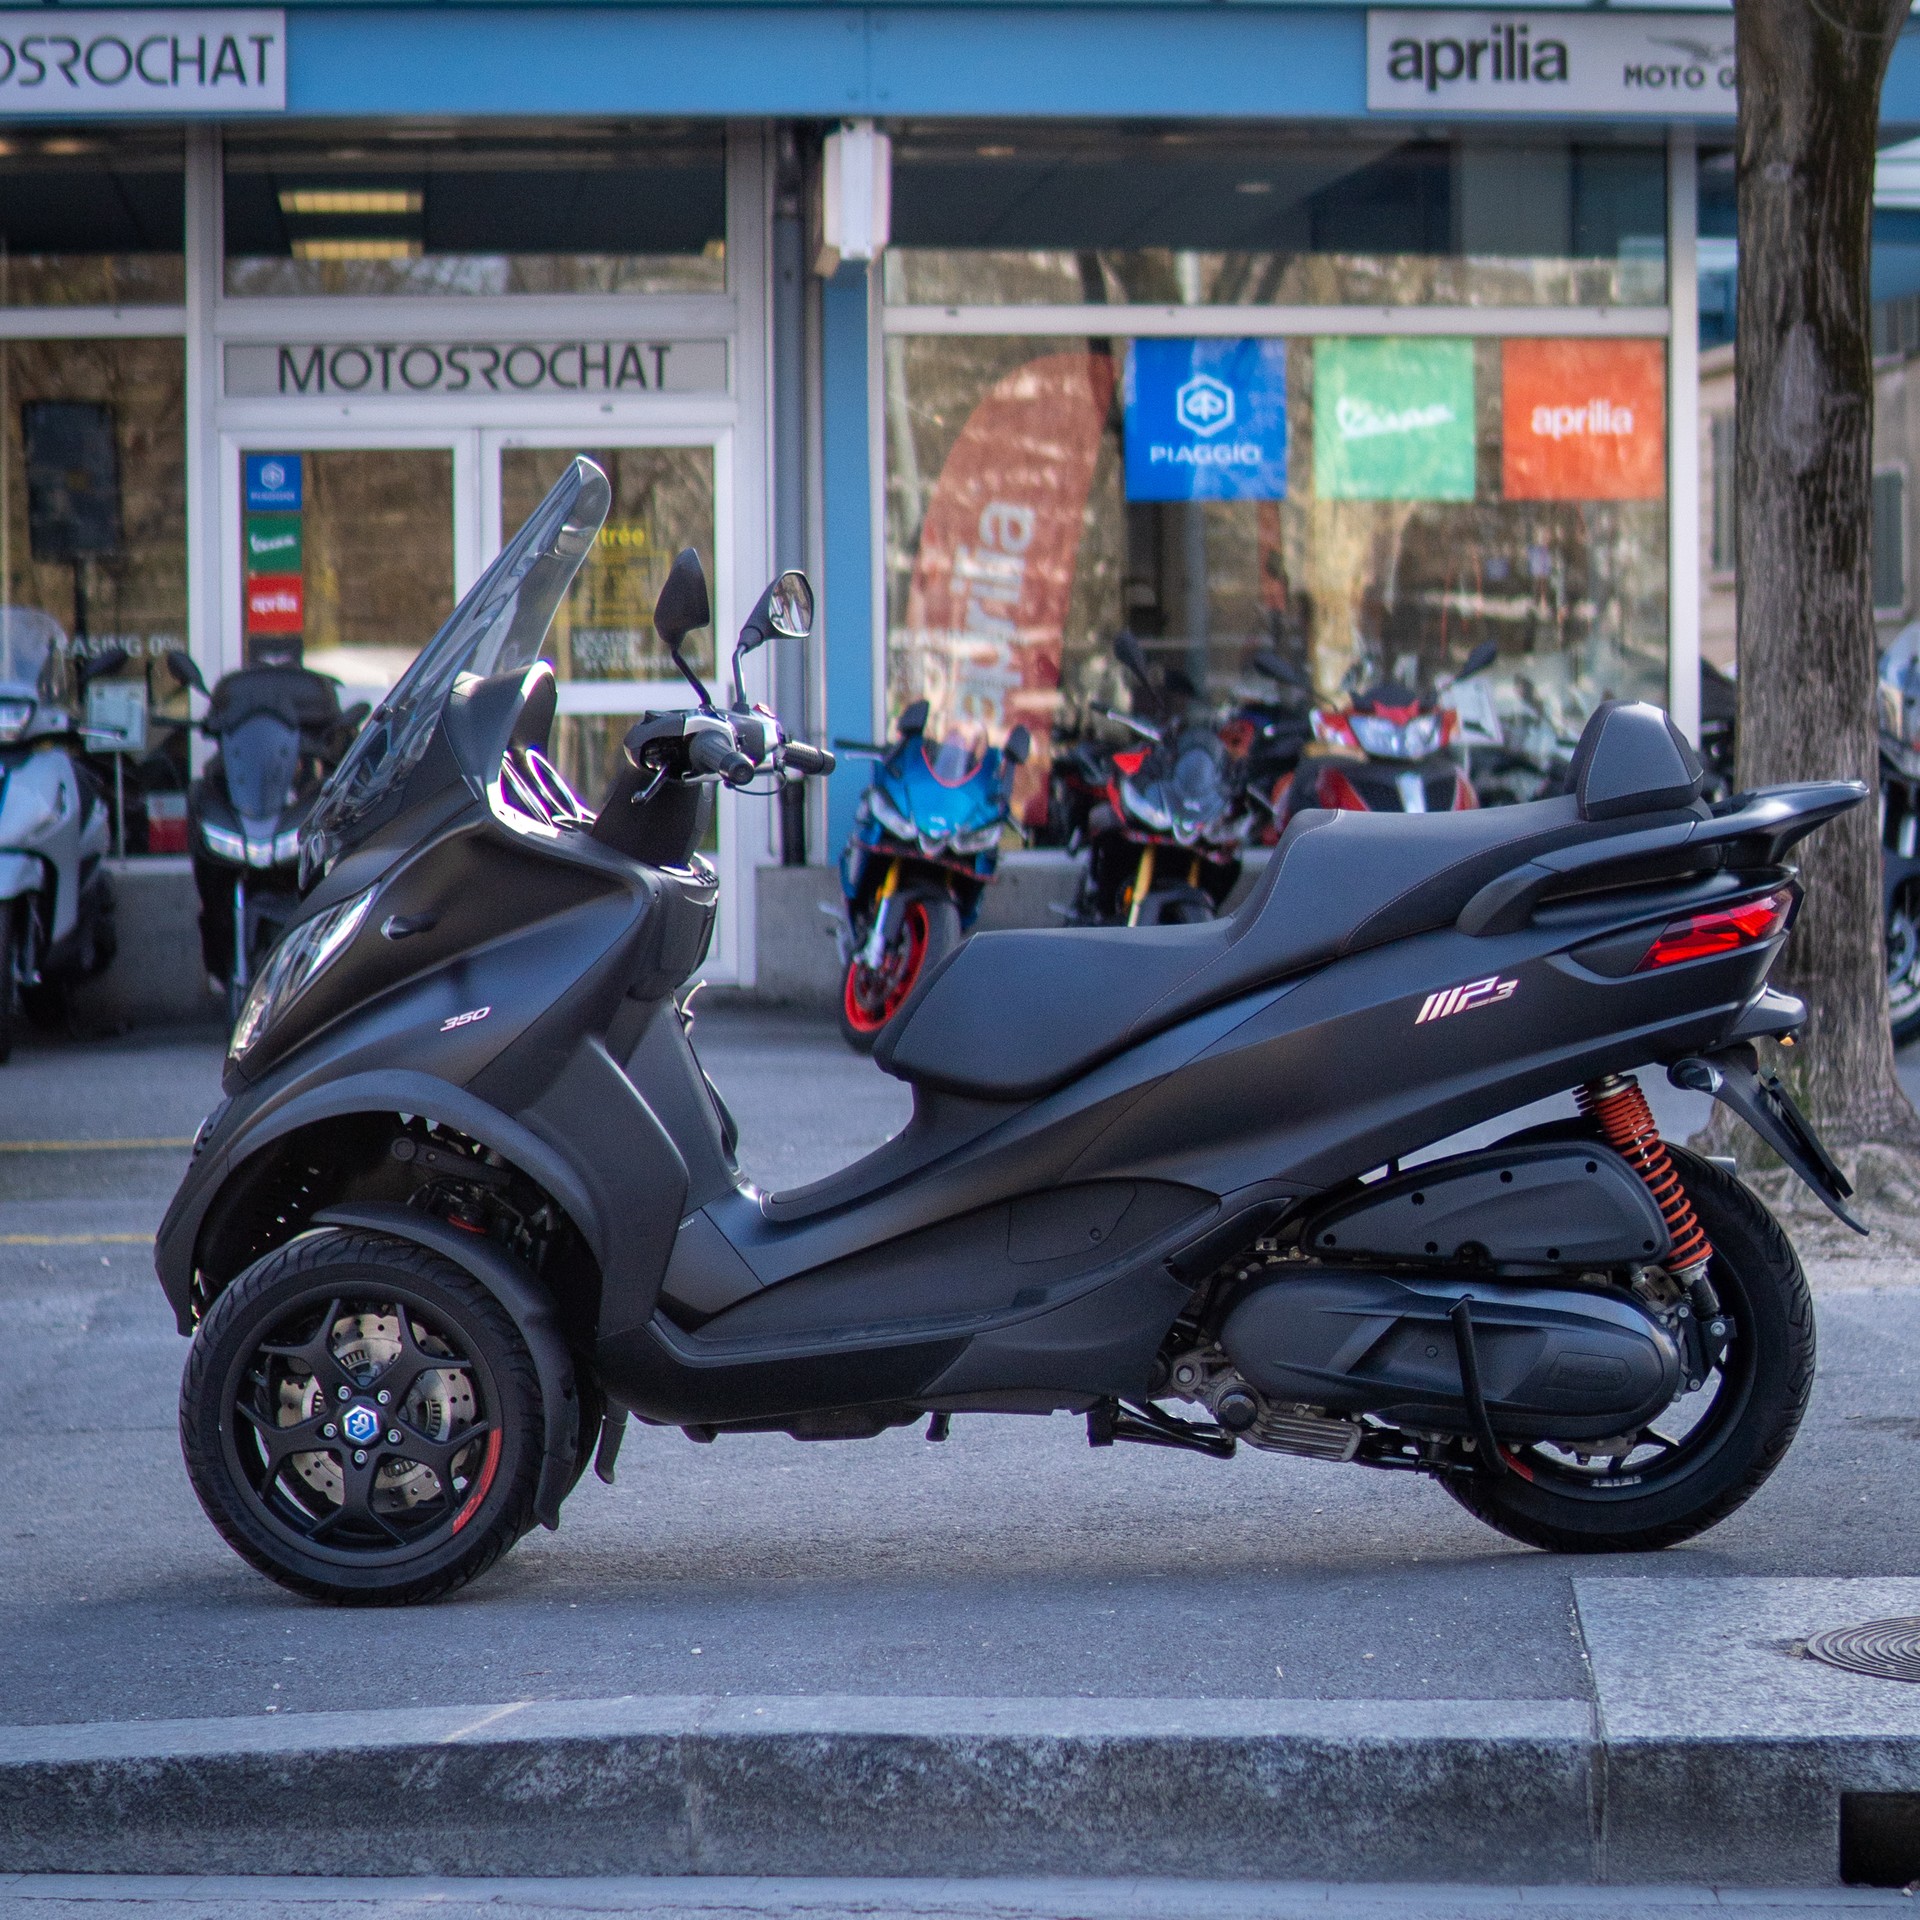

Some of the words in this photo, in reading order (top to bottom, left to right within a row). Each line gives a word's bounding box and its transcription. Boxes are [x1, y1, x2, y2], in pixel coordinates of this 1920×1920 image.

[1387, 23, 1568, 92] aprilia
[1624, 64, 1706, 90] MOTO
[278, 343, 671, 394] MOTOSROCHAT
[1531, 398, 1634, 441] aprilia
[1150, 444, 1262, 465] PIAGGIO
[440, 1006, 491, 1032] 350
[1415, 976, 1518, 1025] MP3
